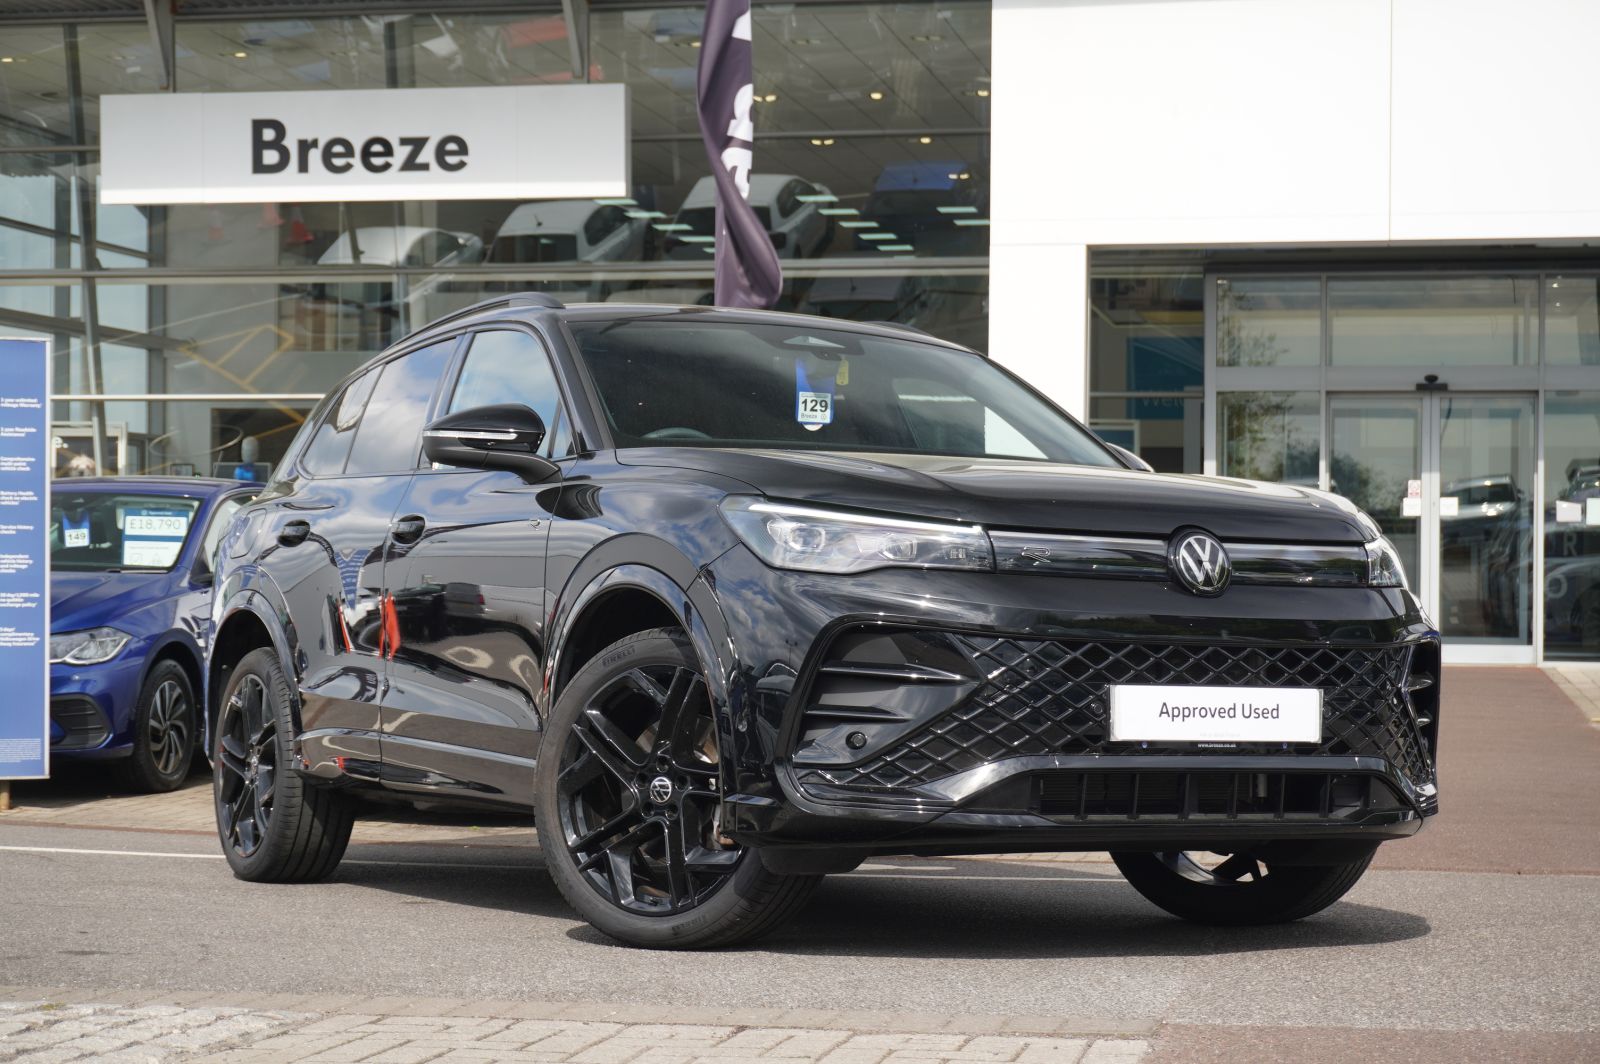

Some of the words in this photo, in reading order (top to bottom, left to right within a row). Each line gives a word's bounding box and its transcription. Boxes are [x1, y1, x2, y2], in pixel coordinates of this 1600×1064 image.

[251, 118, 469, 174] Breeze
[801, 398, 828, 412] 129
[130, 518, 181, 530] £18,790
[67, 532, 86, 541] 149
[1159, 702, 1236, 722] Approved
[1242, 703, 1280, 719] Used
